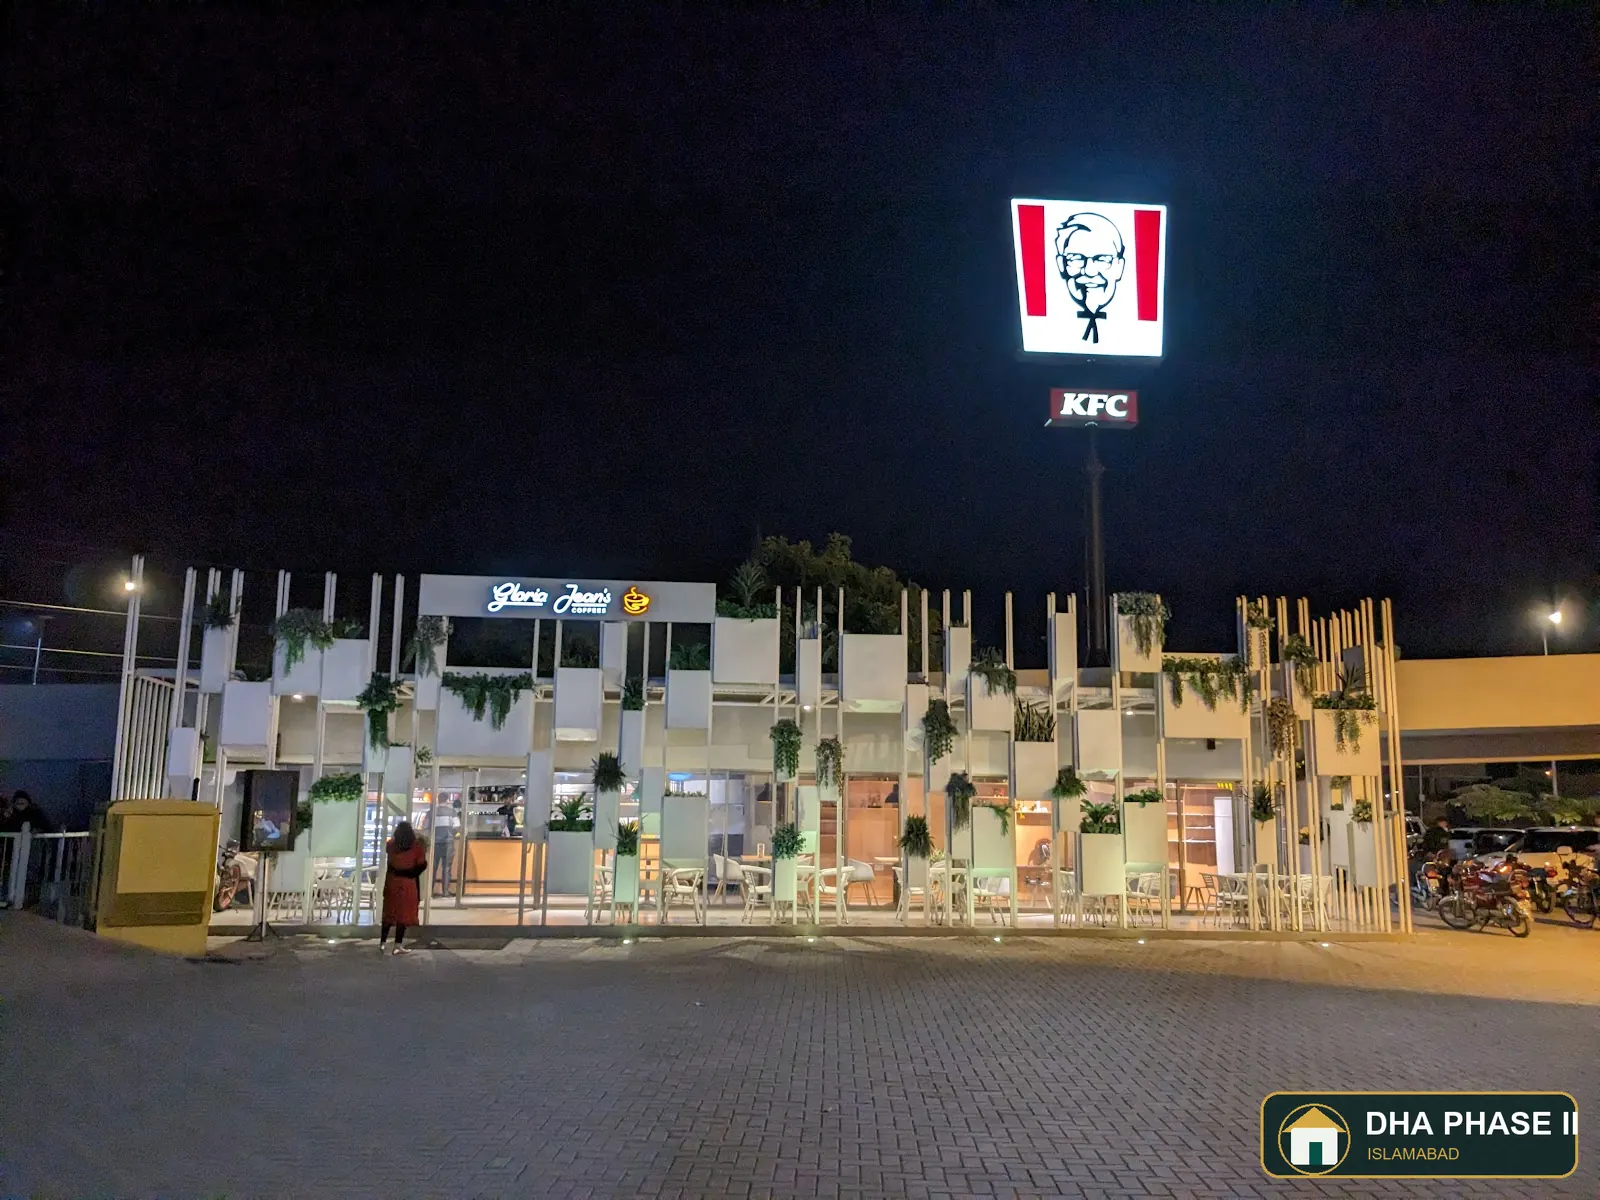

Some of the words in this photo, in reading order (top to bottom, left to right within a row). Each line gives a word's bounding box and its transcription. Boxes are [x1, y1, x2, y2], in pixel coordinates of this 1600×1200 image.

[1060, 392, 1128, 418] KFC
[487, 582, 549, 612] Gloria
[553, 583, 612, 614] Jean's
